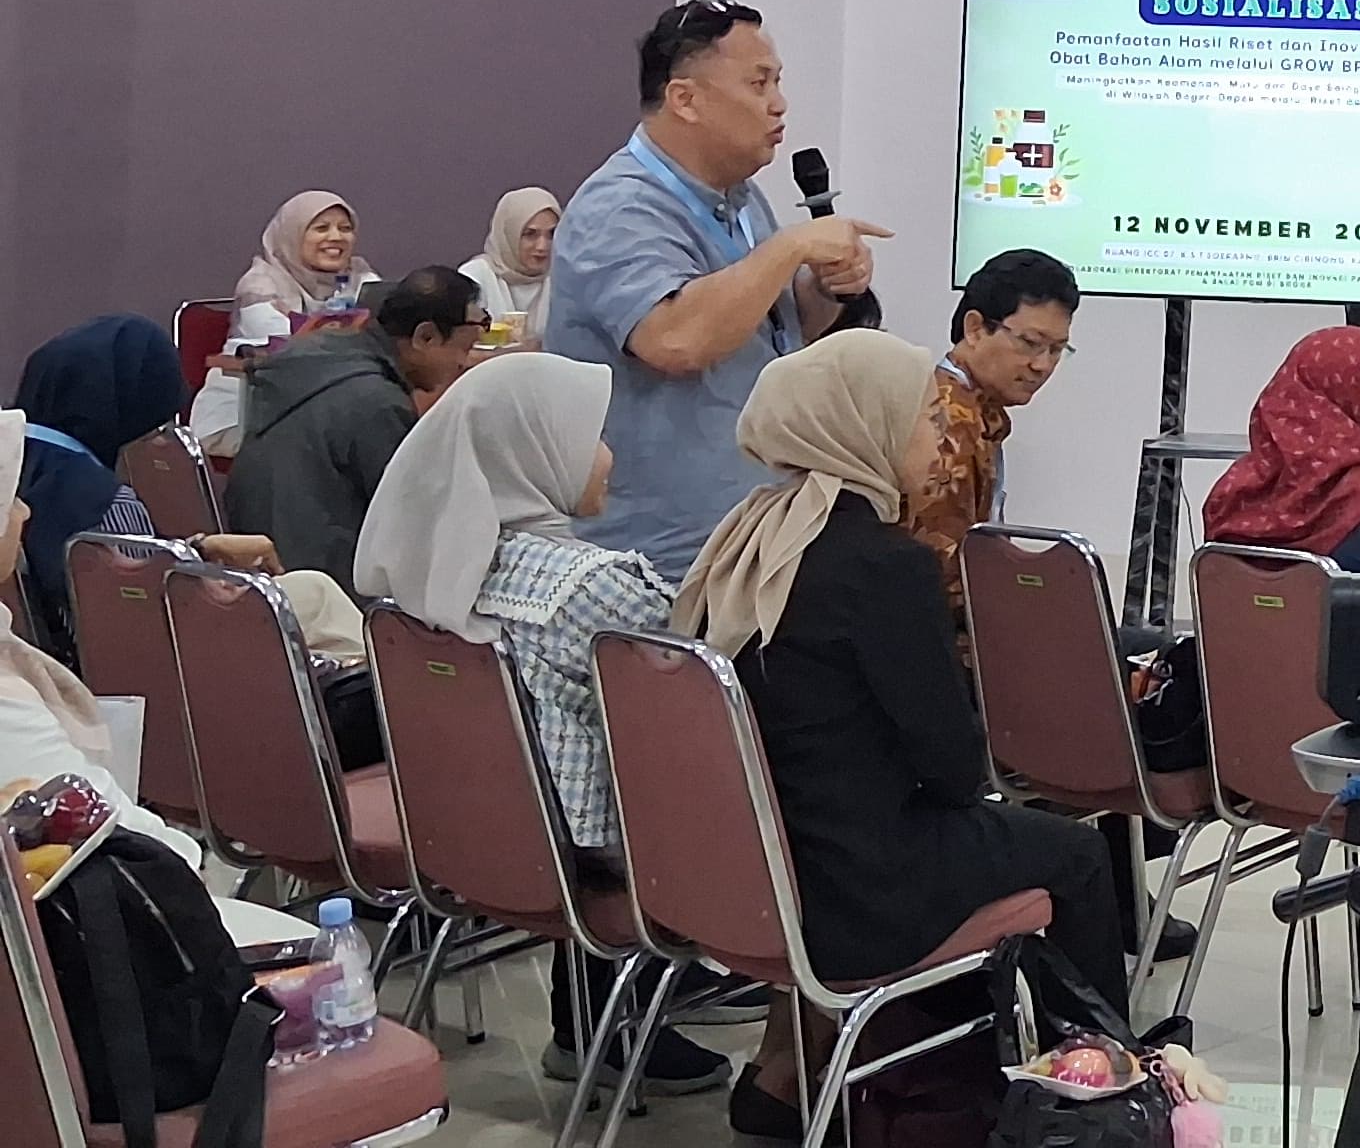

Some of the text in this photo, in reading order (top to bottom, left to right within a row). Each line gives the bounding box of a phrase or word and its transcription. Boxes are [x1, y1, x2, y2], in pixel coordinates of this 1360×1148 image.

[1056, 31, 1171, 47] Pemanfaatan
[1179, 35, 1222, 49] Hasil
[1229, 37, 1273, 50] Riset
[1280, 39, 1312, 52] dan
[1050, 51, 1091, 65] Obat
[1098, 52, 1151, 67] Bahan
[1159, 54, 1202, 69] Alam
[1210, 56, 1273, 70] melalui
[1280, 59, 1334, 72] GROW
[1113, 215, 1140, 233] 12
[1154, 216, 1311, 239] NOVEMBER
